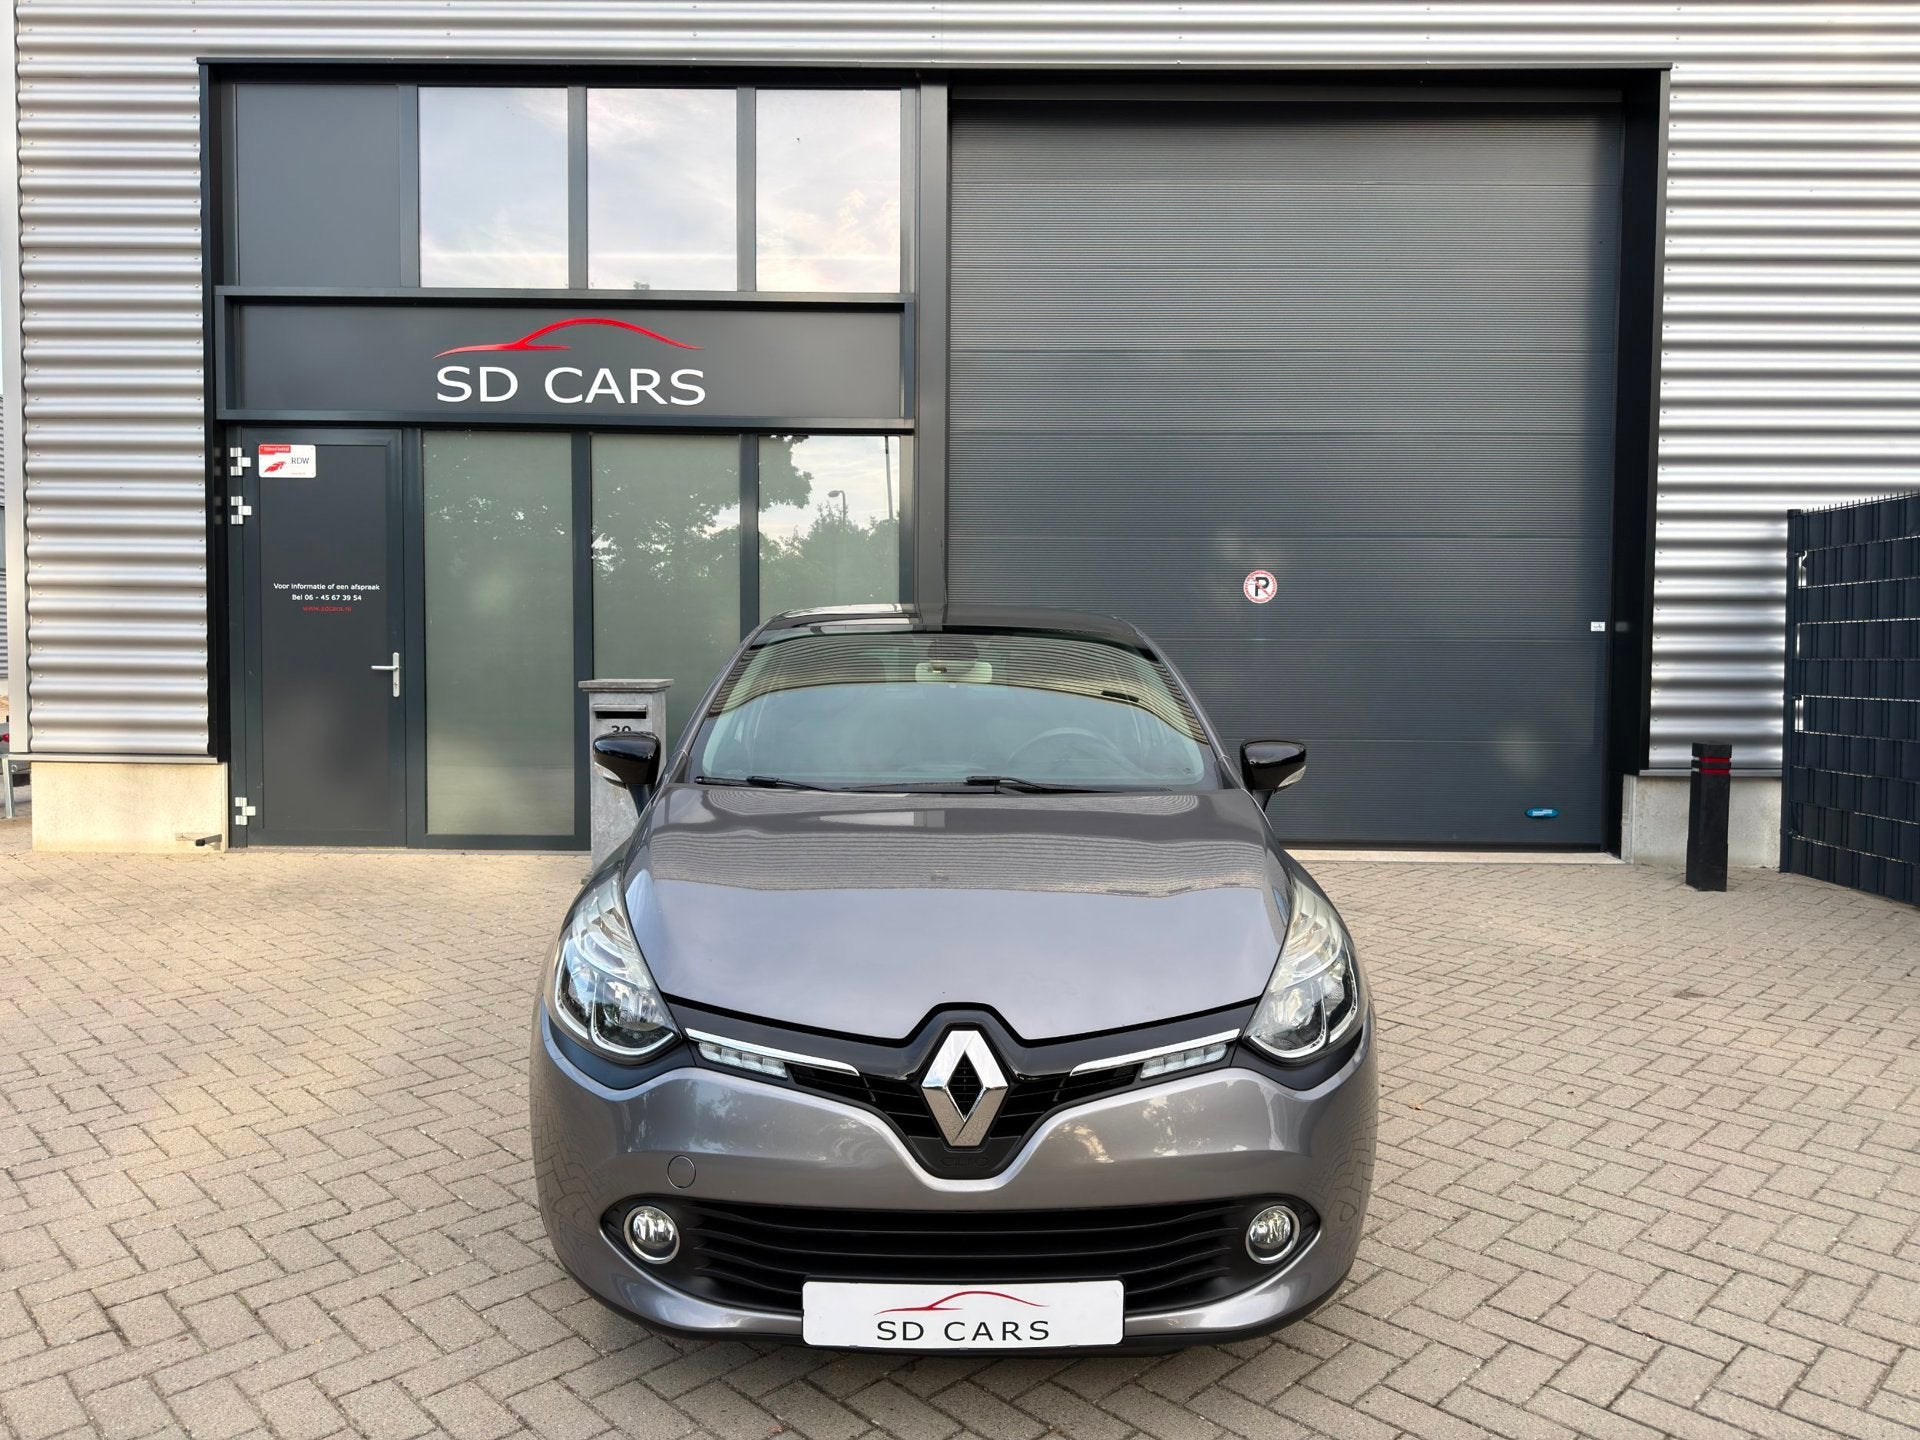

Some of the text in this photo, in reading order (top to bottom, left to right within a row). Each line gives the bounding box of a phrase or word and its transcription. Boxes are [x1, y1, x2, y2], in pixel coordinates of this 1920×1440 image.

[436, 365, 706, 405] SD CARS
[1255, 576, 1270, 597] P
[876, 1320, 1050, 1342] SD CARS
